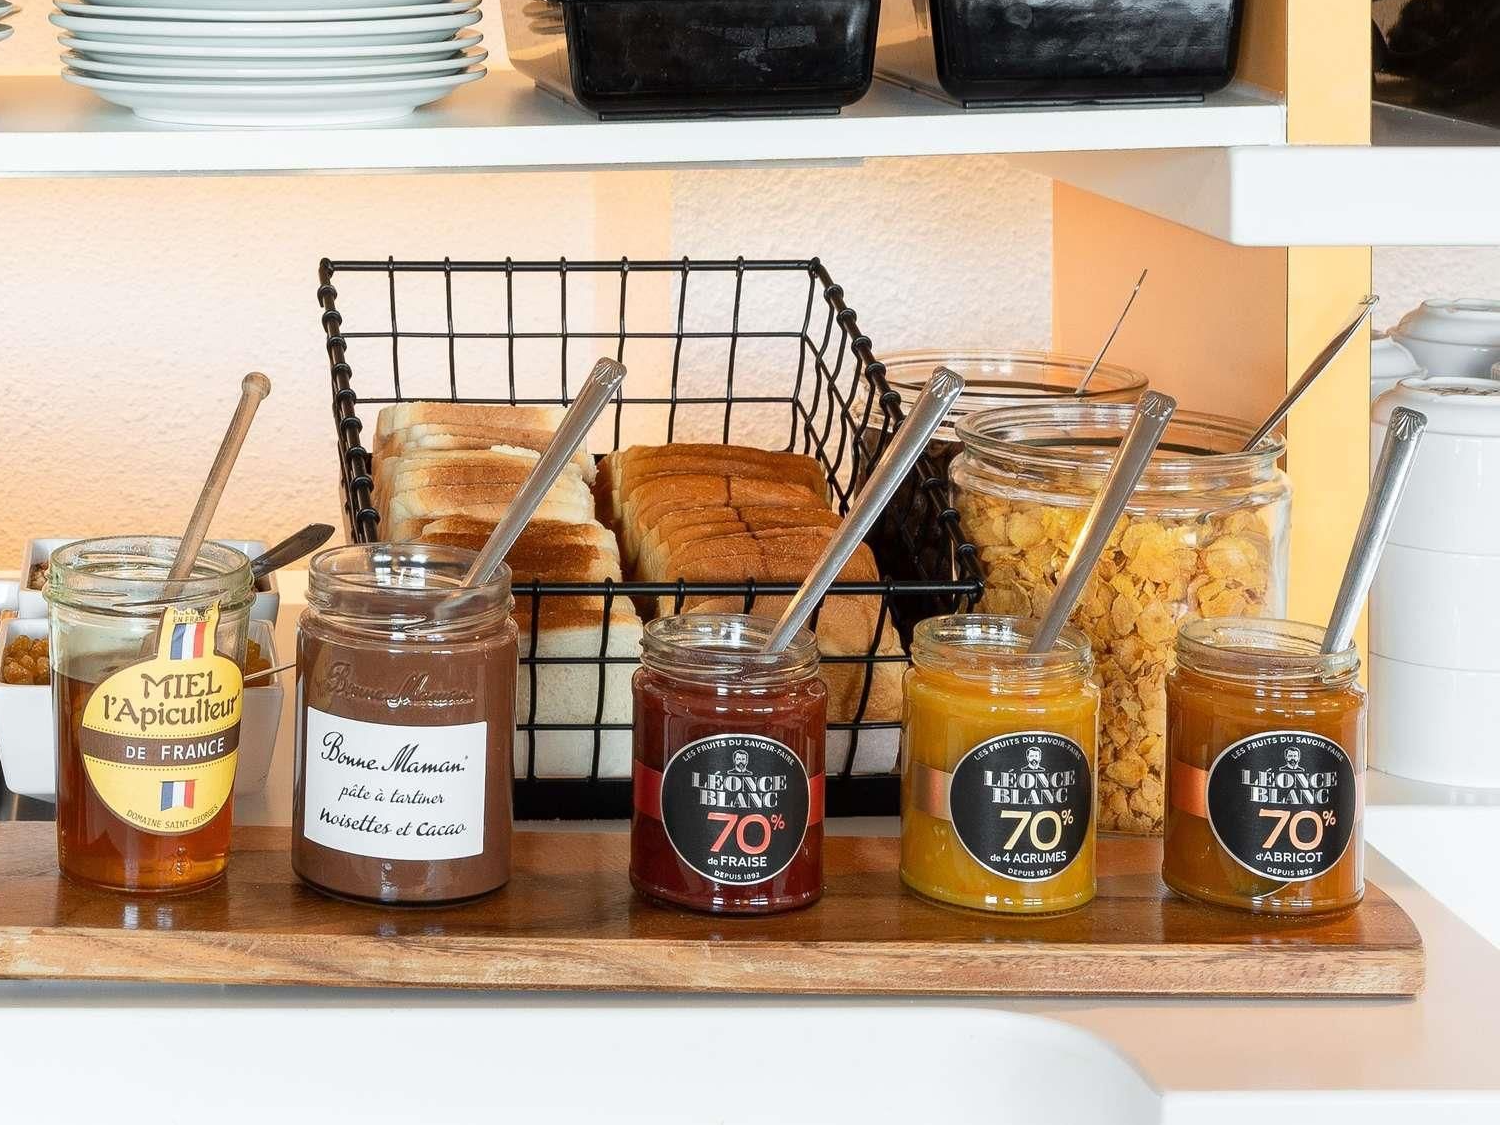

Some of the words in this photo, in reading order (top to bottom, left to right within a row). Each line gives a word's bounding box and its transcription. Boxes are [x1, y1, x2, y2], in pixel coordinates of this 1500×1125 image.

[140, 670, 222, 699] MIEL
[126, 746, 147, 760] DE
[161, 737, 225, 761] FRANCE
[321, 731, 378, 770] Bonne
[682, 750, 697, 762] LES
[697, 740, 726, 754] FRUITS
[729, 739, 742, 747] DU
[744, 739, 795, 766] SAVOIR-FAIRE
[973, 748, 989, 761] LES
[989, 738, 1020, 752] FRUITS
[1022, 736, 1035, 744] DU
[1231, 747, 1246, 760] LES
[1246, 737, 1278, 752] FRUITS
[1280, 736, 1293, 744] DU
[1295, 736, 1344, 762] SAVOIR-FAIRE
[692, 771, 787, 792] LÉONCE
[983, 768, 1076, 789] LÉONCE
[1241, 768, 1338, 789] LÉONCE
[338, 784, 371, 802] pâte
[375, 789, 385, 801] à
[390, 789, 445, 804] tartiner
[700, 789, 778, 808] BLANC
[991, 787, 1068, 805] BLANC
[1250, 786, 1330, 805] BLANC
[126, 809, 161, 828] DOMAINE
[396, 822, 412, 836] et
[707, 811, 786, 855] 70%
[1000, 808, 1074, 851] 70%
[1258, 808, 1336, 851] 70%
[707, 856, 719, 866] de
[720, 855, 768, 867] FRAISE
[990, 853, 1001, 863] de
[1002, 854, 1010, 863] 4
[1012, 851, 1067, 864] AGRUMES
[1255, 851, 1323, 863] d'ABRICOT
[714, 870, 742, 880] DEPUIS
[1007, 867, 1035, 877] DEPUIS
[1267, 866, 1295, 877] DEPUIS
